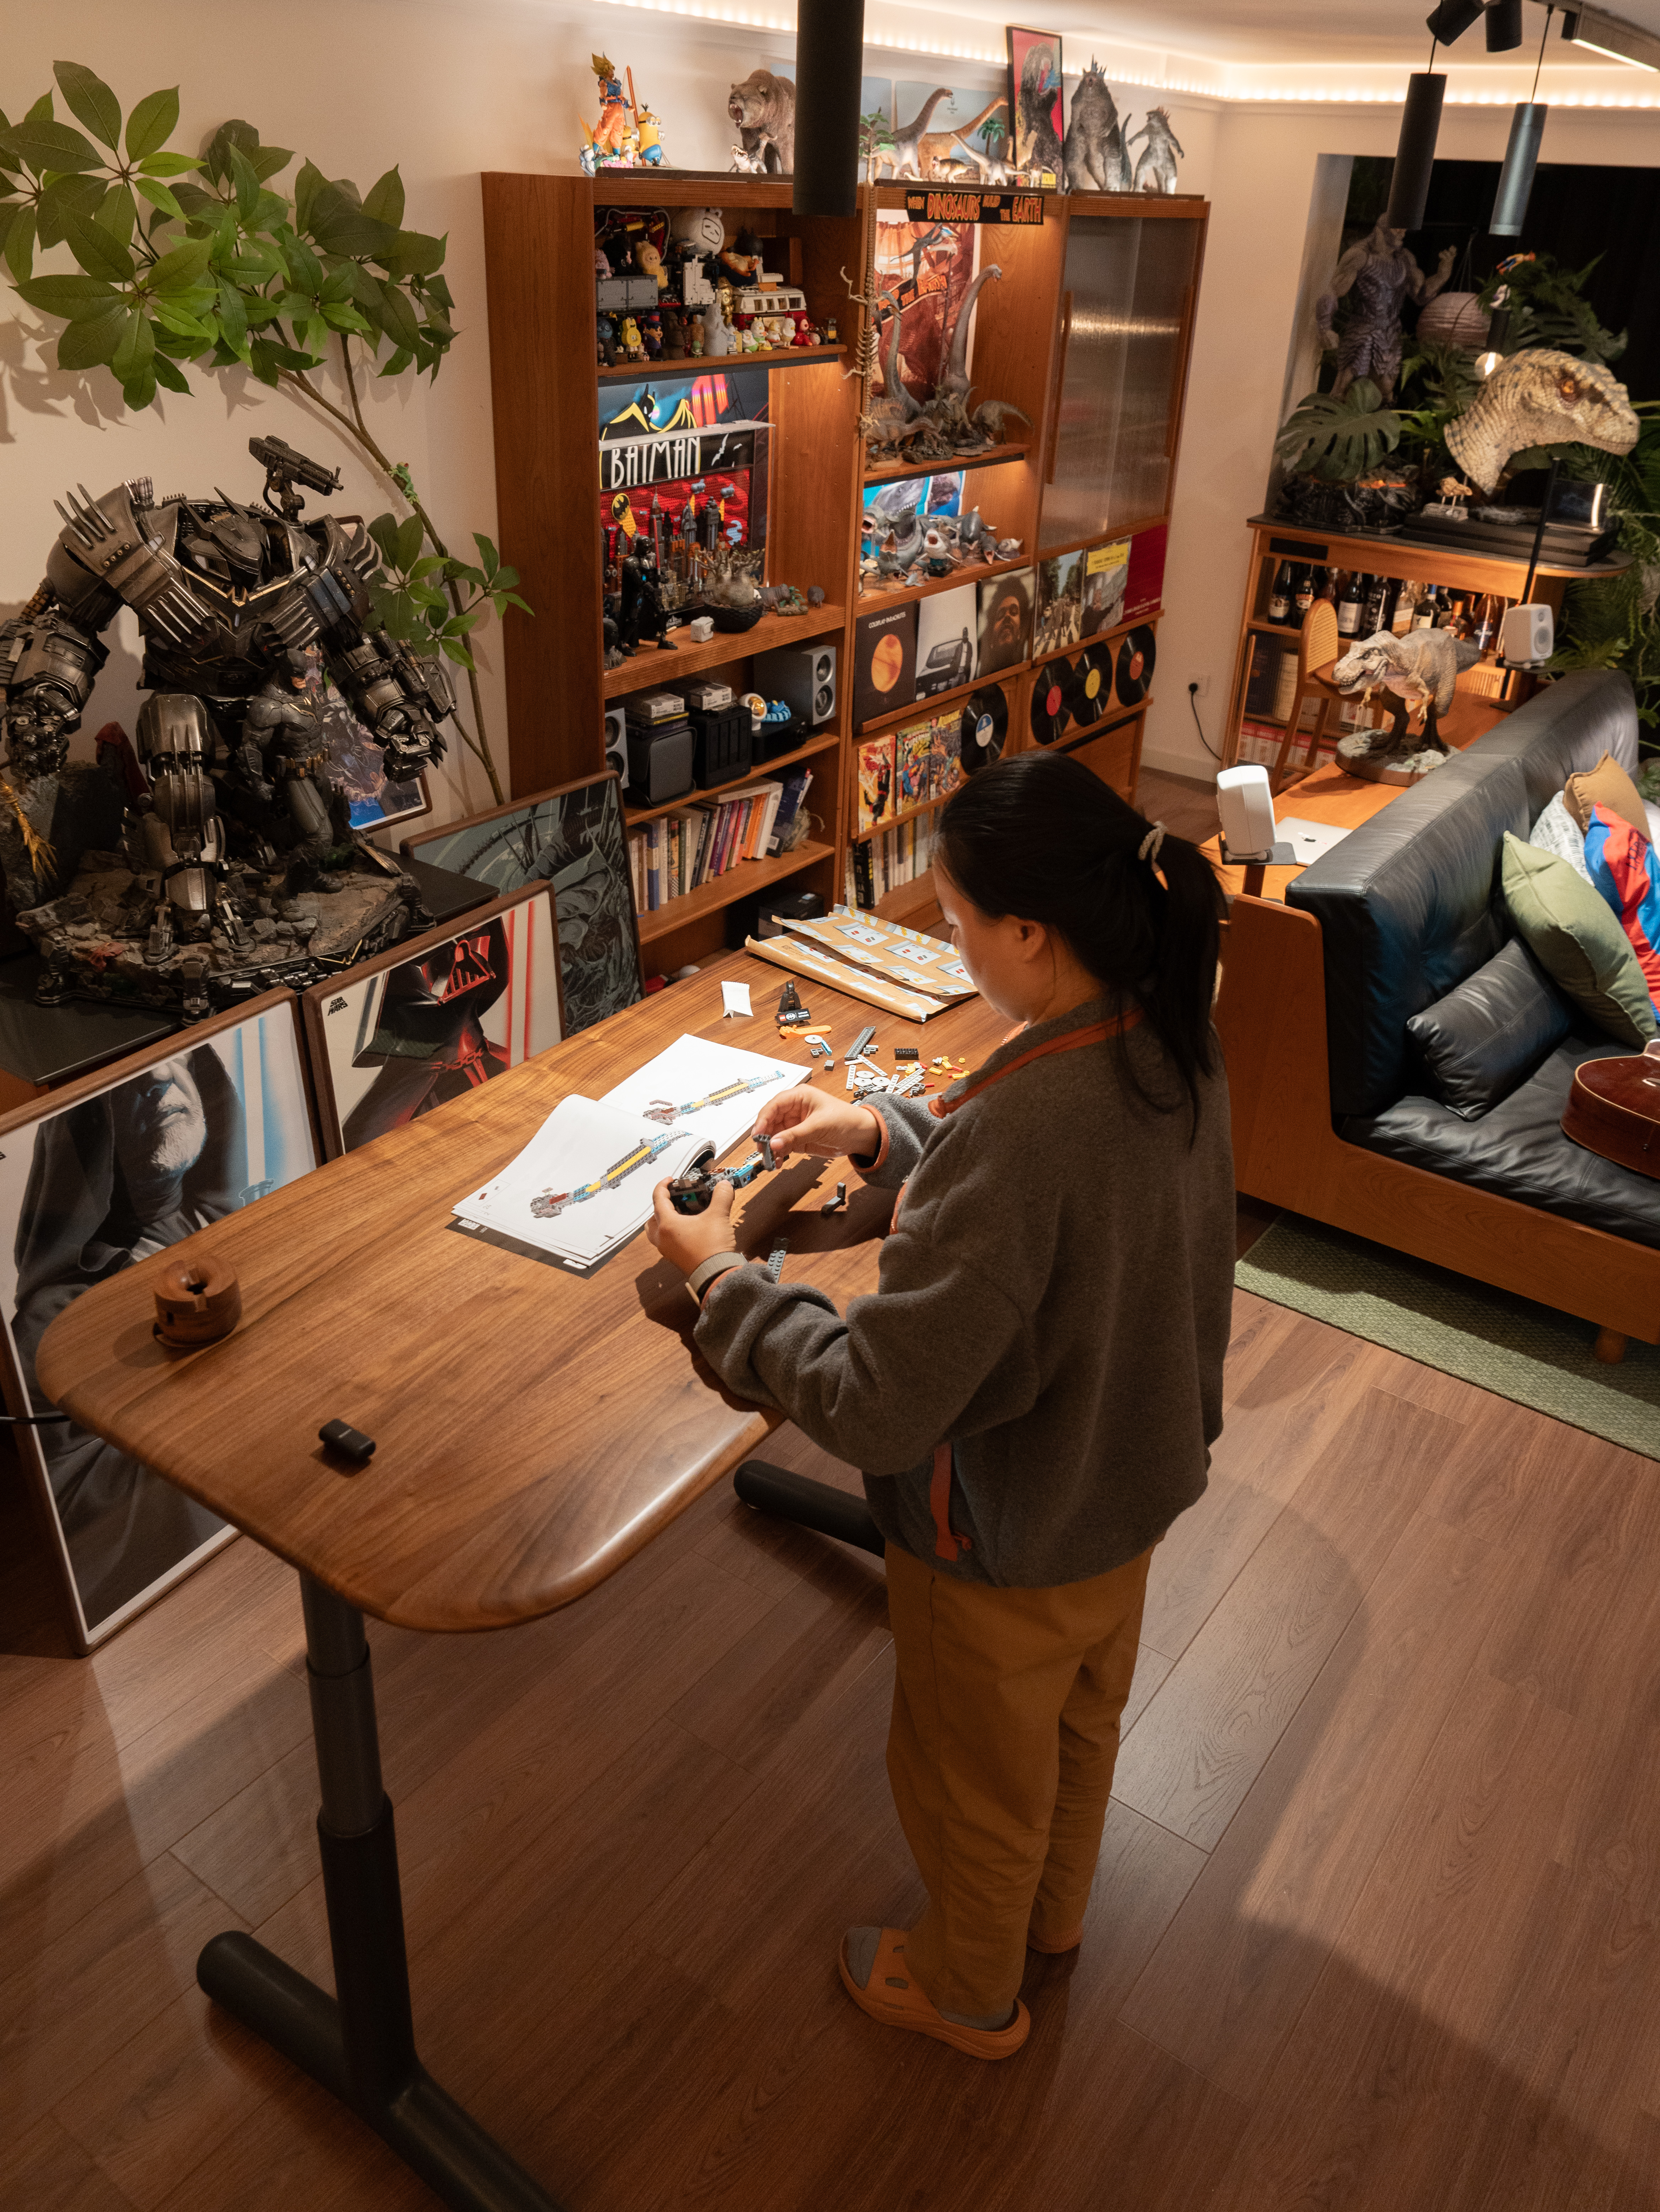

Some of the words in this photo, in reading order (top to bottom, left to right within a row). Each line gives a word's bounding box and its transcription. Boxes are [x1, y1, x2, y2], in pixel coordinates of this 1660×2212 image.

[907, 196, 925, 209] WHEN
[927, 192, 981, 220] DINOSAURS
[1000, 209, 1010, 221] THE
[1012, 196, 1042, 222] EARTH
[611, 436, 700, 488] BATMAN
[328, 1003, 348, 1016] WARS
[330, 997, 346, 1008] STAR
